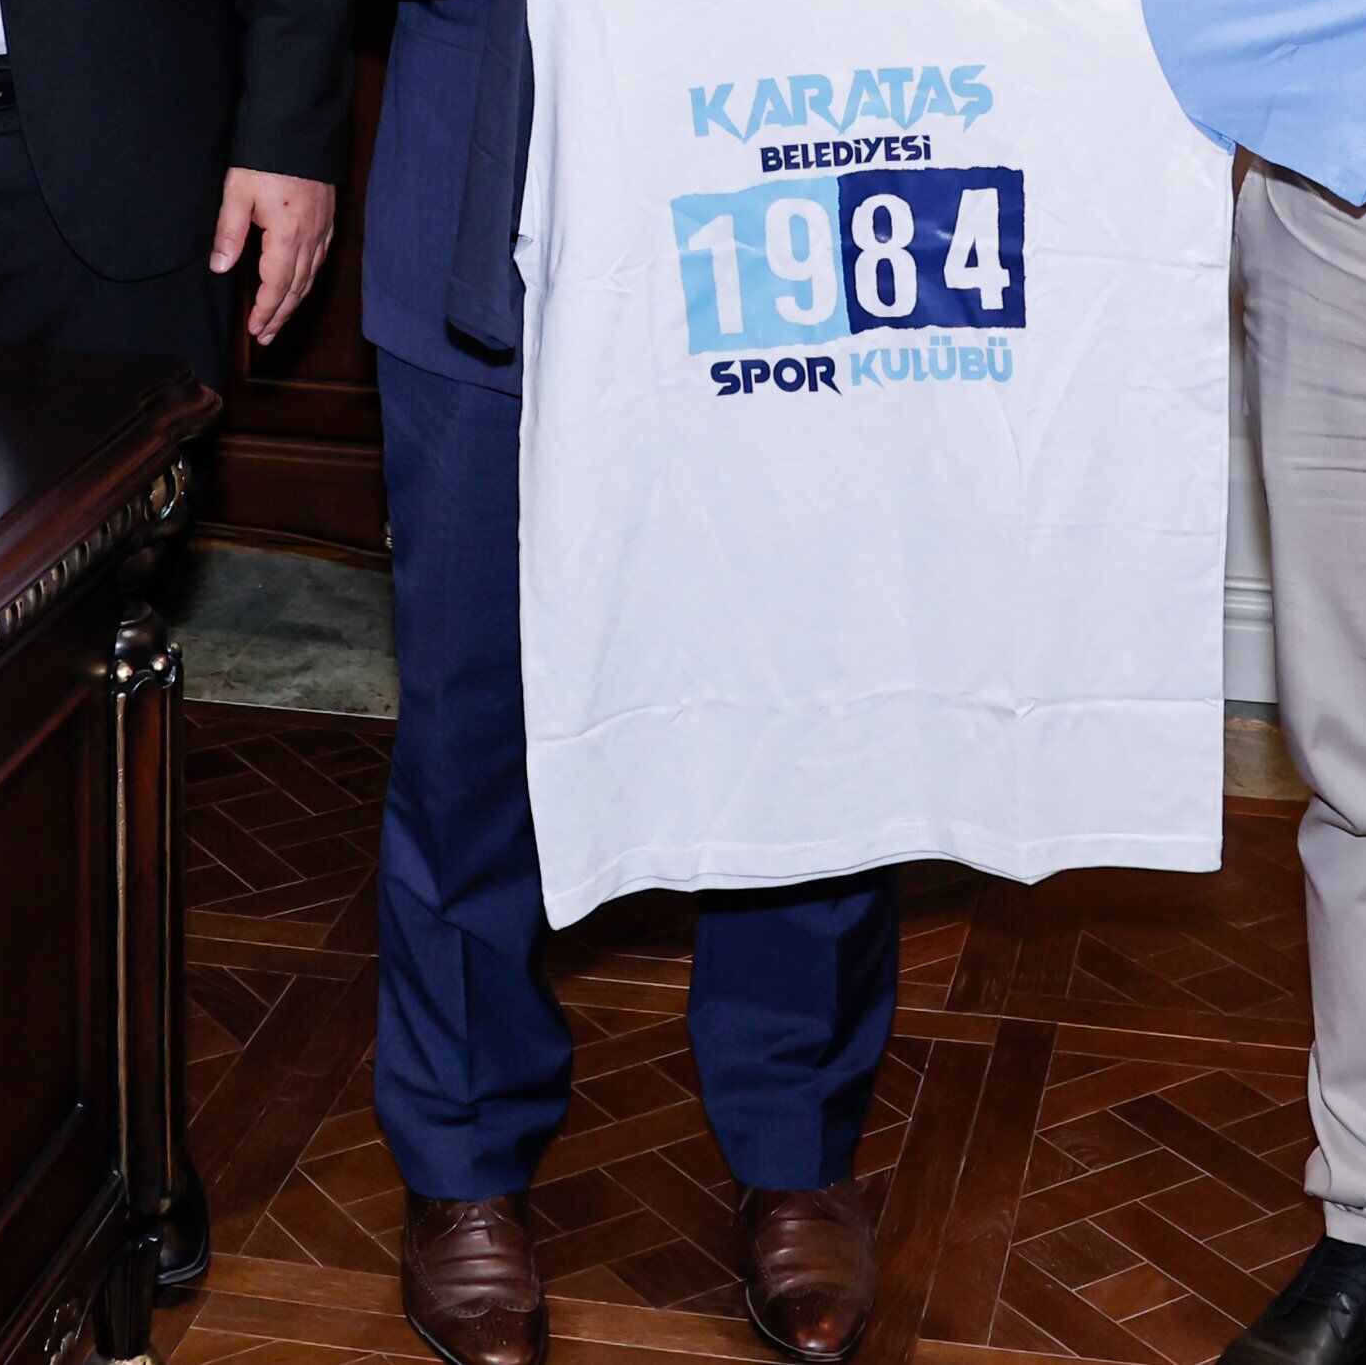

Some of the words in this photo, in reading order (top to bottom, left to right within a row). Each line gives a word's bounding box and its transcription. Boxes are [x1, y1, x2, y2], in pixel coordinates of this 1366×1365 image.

[688, 64, 995, 144] KARATAŞ
[687, 187, 1011, 335] 1984
[710, 356, 843, 396] SPOR
[849, 336, 1014, 389] KULÜBÜ
